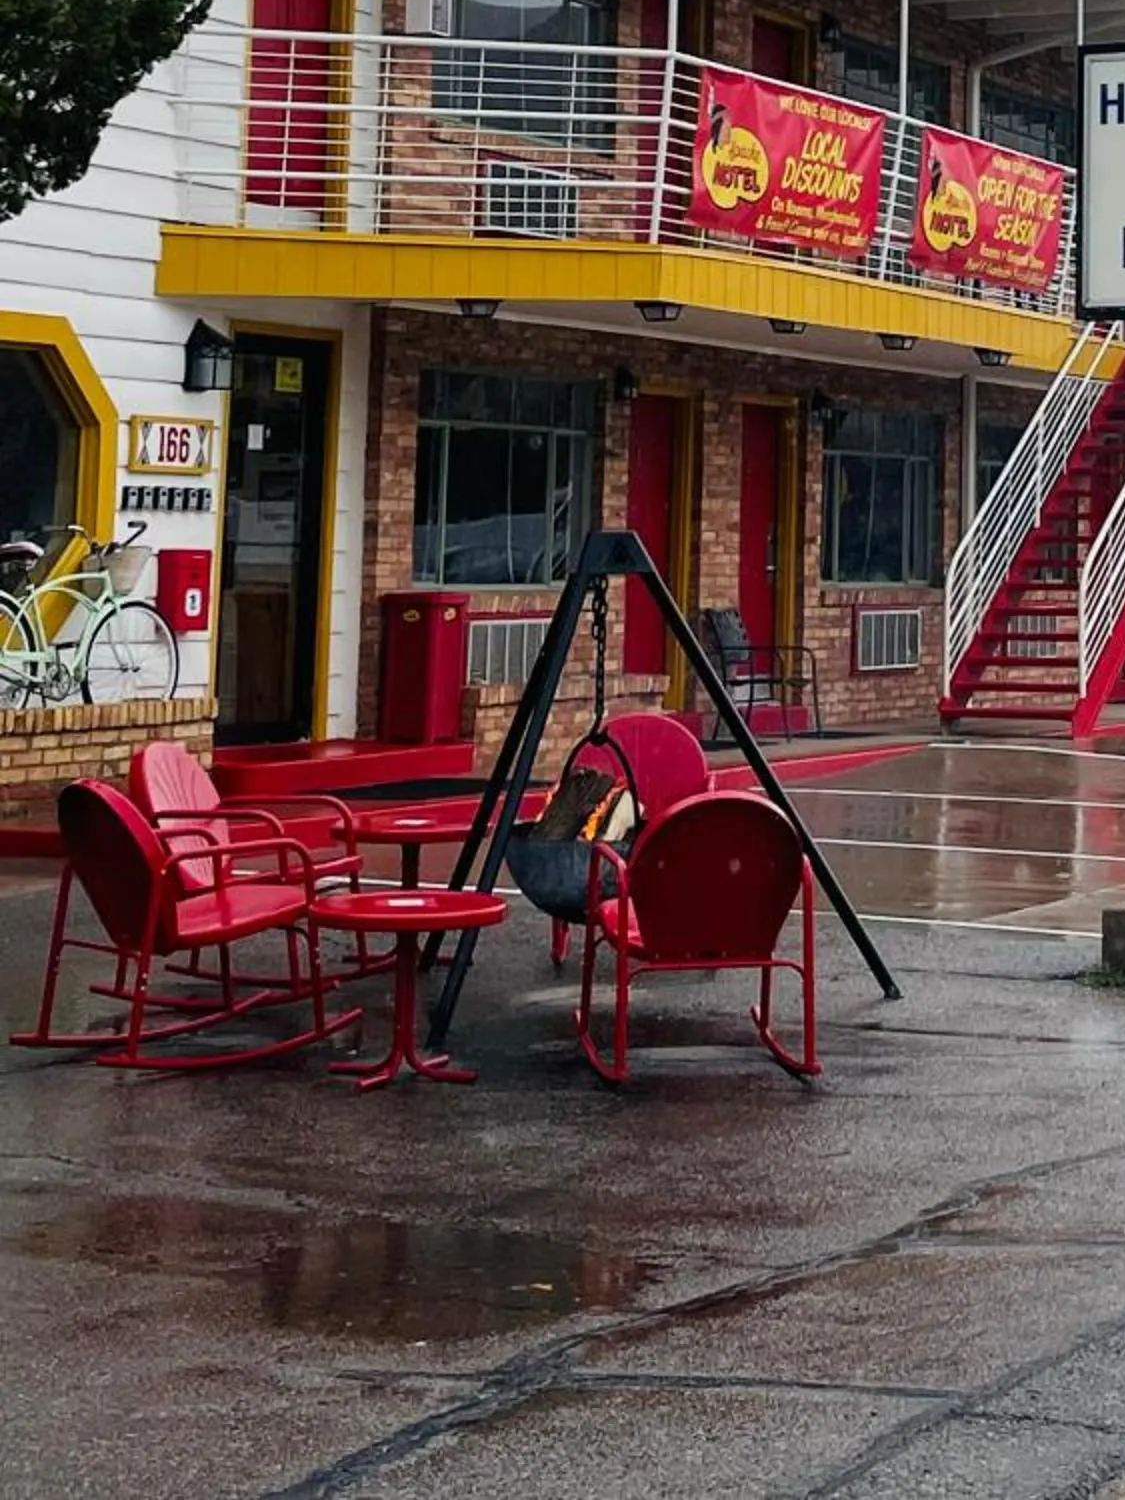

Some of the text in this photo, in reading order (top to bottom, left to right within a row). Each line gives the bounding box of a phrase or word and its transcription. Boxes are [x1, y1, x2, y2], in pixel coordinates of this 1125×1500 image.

[801, 128, 847, 168] LOCAL
[781, 156, 864, 203] DISCOUNTS
[978, 175, 1014, 208] OPEN
[1013, 185, 1038, 216] FOR
[993, 213, 1040, 248] SEASON
[157, 426, 191, 463] 166
